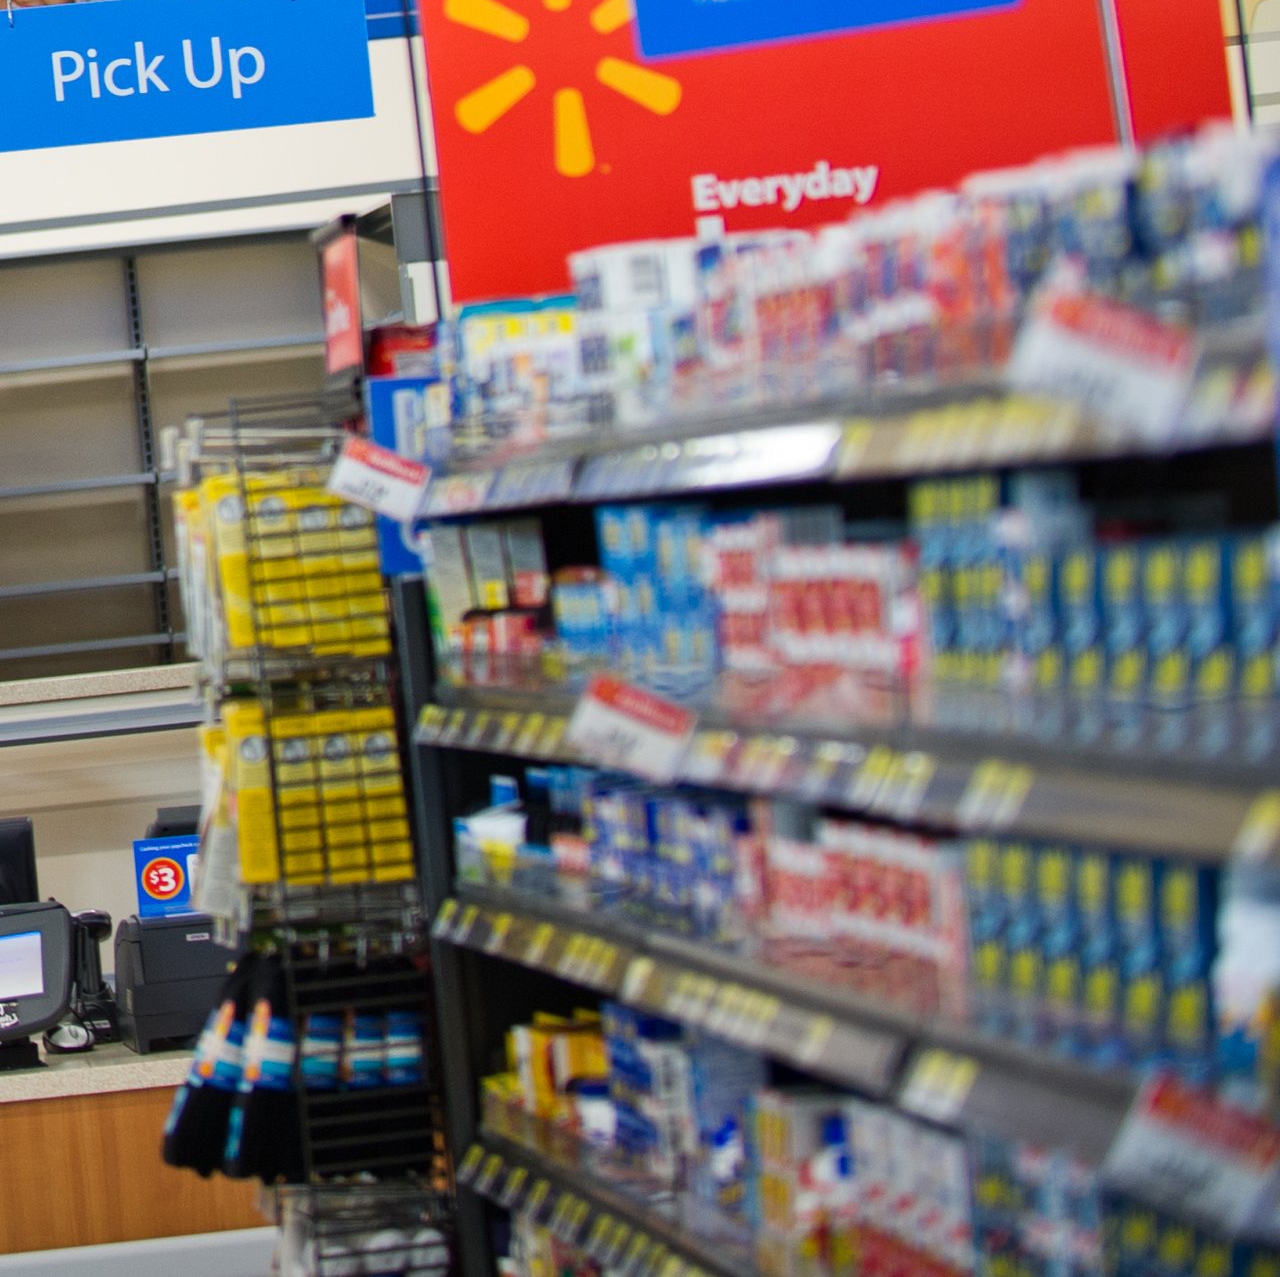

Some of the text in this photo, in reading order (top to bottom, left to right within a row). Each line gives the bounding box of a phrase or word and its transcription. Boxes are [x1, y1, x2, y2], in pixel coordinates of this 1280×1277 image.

[51, 36, 265, 102] Pick Up
[692, 160, 879, 213] Everyday
[149, 867, 176, 892] $3
